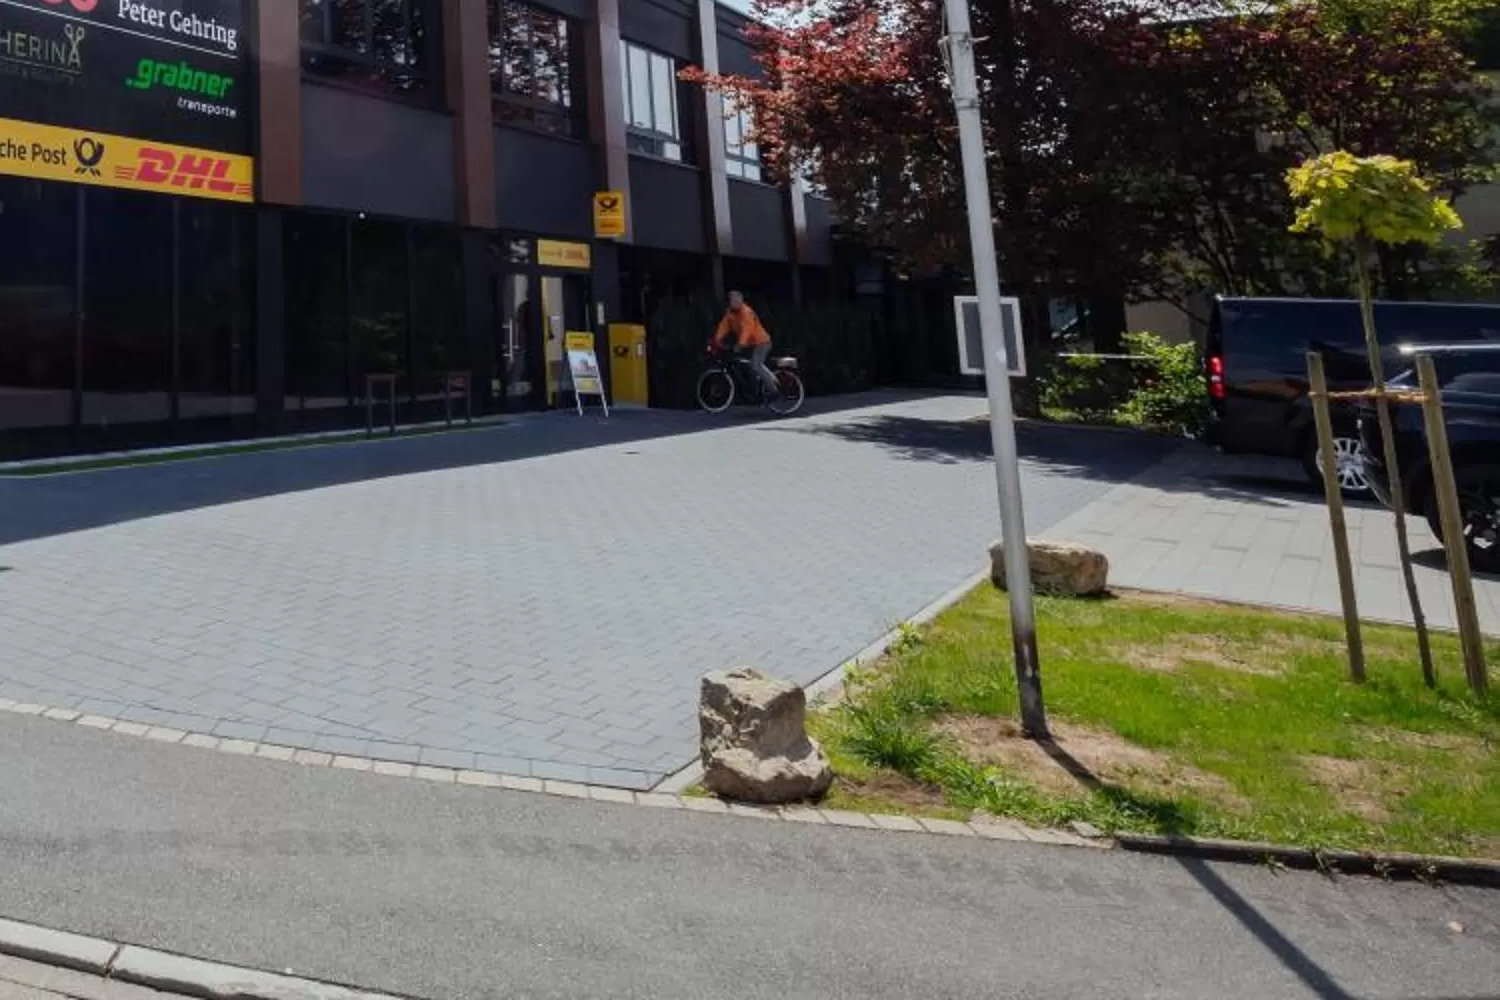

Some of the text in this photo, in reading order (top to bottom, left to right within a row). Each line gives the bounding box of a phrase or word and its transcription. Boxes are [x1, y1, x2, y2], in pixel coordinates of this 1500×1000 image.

[169, 9, 237, 51] Gehring
[176, 96, 237, 118] transporte
[31, 143, 67, 166] Post
[134, 146, 236, 193] DHL
